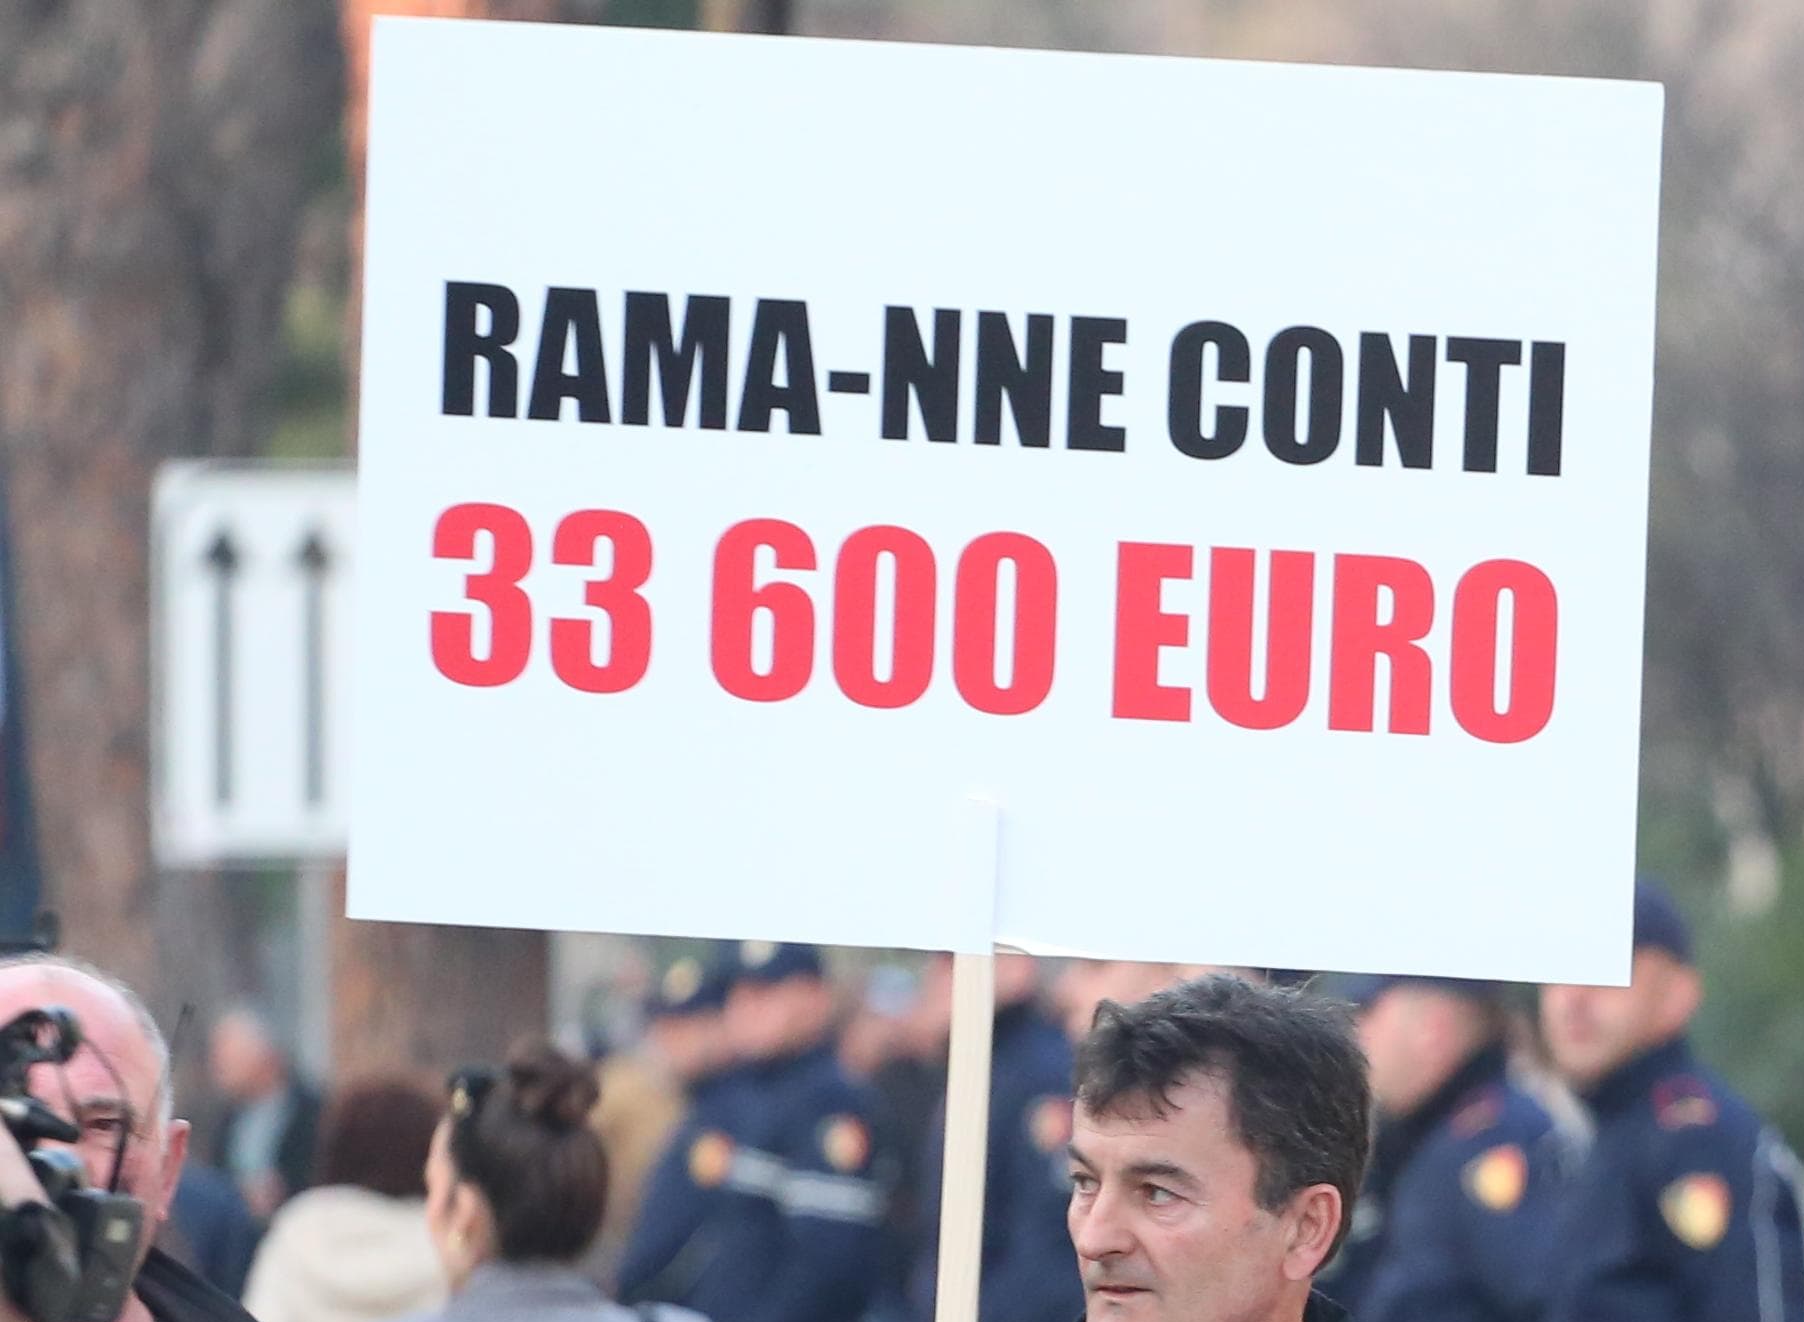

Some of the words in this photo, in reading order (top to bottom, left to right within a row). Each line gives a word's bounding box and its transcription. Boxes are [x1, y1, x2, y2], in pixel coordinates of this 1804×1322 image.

[443, 282, 1126, 452] RAMA-NNE
[1169, 322, 1564, 476] CONTI
[431, 503, 652, 693] 33
[711, 519, 1057, 715] 600
[1113, 542, 1557, 743] EURO
